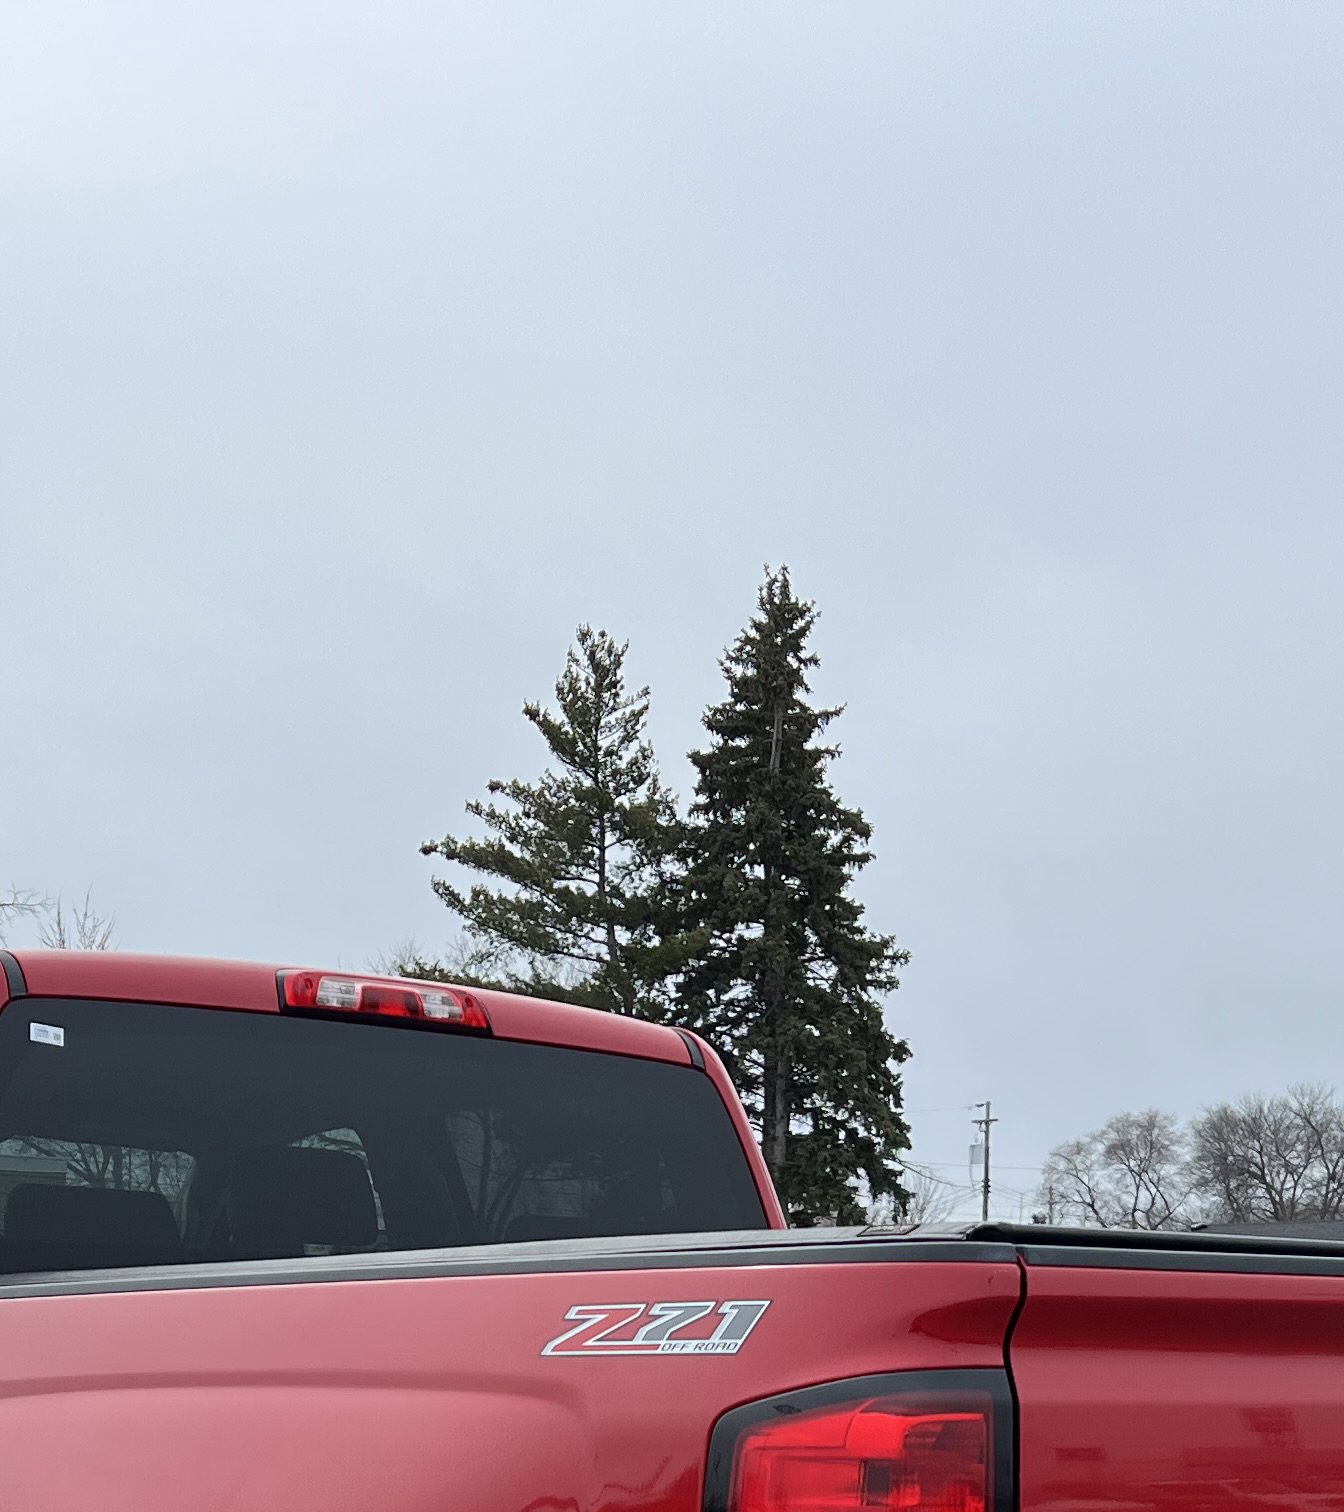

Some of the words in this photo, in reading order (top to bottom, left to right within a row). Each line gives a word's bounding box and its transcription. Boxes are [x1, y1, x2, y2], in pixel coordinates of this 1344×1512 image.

[541, 1300, 772, 1356] Z71
[660, 1342, 692, 1352] OFF
[693, 1341, 738, 1352] ROAD
